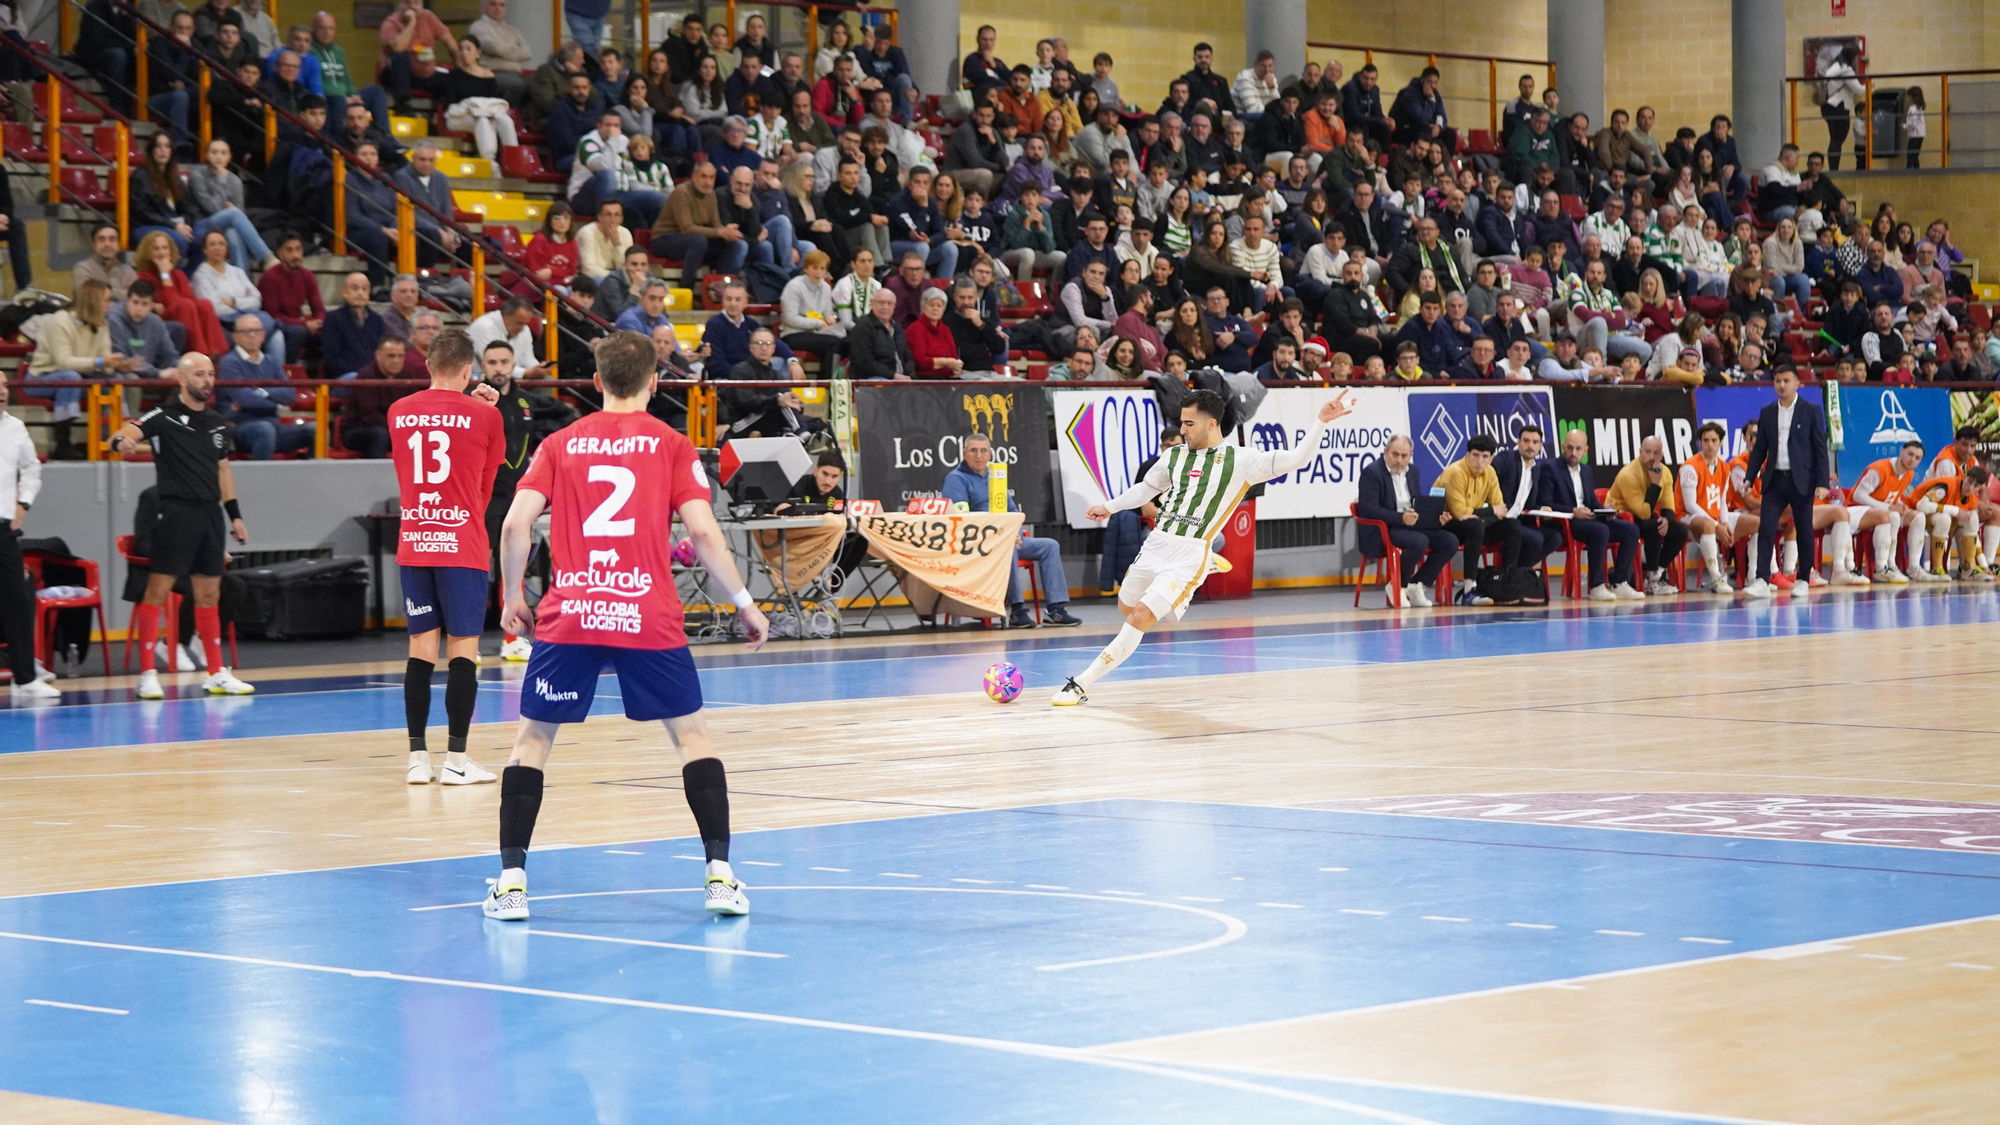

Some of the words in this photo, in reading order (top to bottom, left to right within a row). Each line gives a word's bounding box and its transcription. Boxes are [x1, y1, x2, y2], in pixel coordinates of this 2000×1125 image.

[395, 414, 472, 429] KORSUN
[1464, 411, 1546, 444] UNIÓN
[566, 435, 660, 456] GERAGHTY
[893, 437, 933, 469] Los
[1593, 418, 1694, 466] MILAR
[407, 430, 451, 484] 13
[1296, 453, 1385, 484] PASTO
[582, 464, 636, 538] 2
[402, 532, 421, 542] SCAN
[422, 531, 458, 543] GLOBAL
[413, 542, 459, 553] LOGISTICS
[555, 565, 653, 592] lacturale
[560, 599, 592, 615] SCAN
[593, 600, 642, 618] GLOBAL
[580, 614, 642, 634] LOGISTICS
[545, 684, 578, 702] elektra
